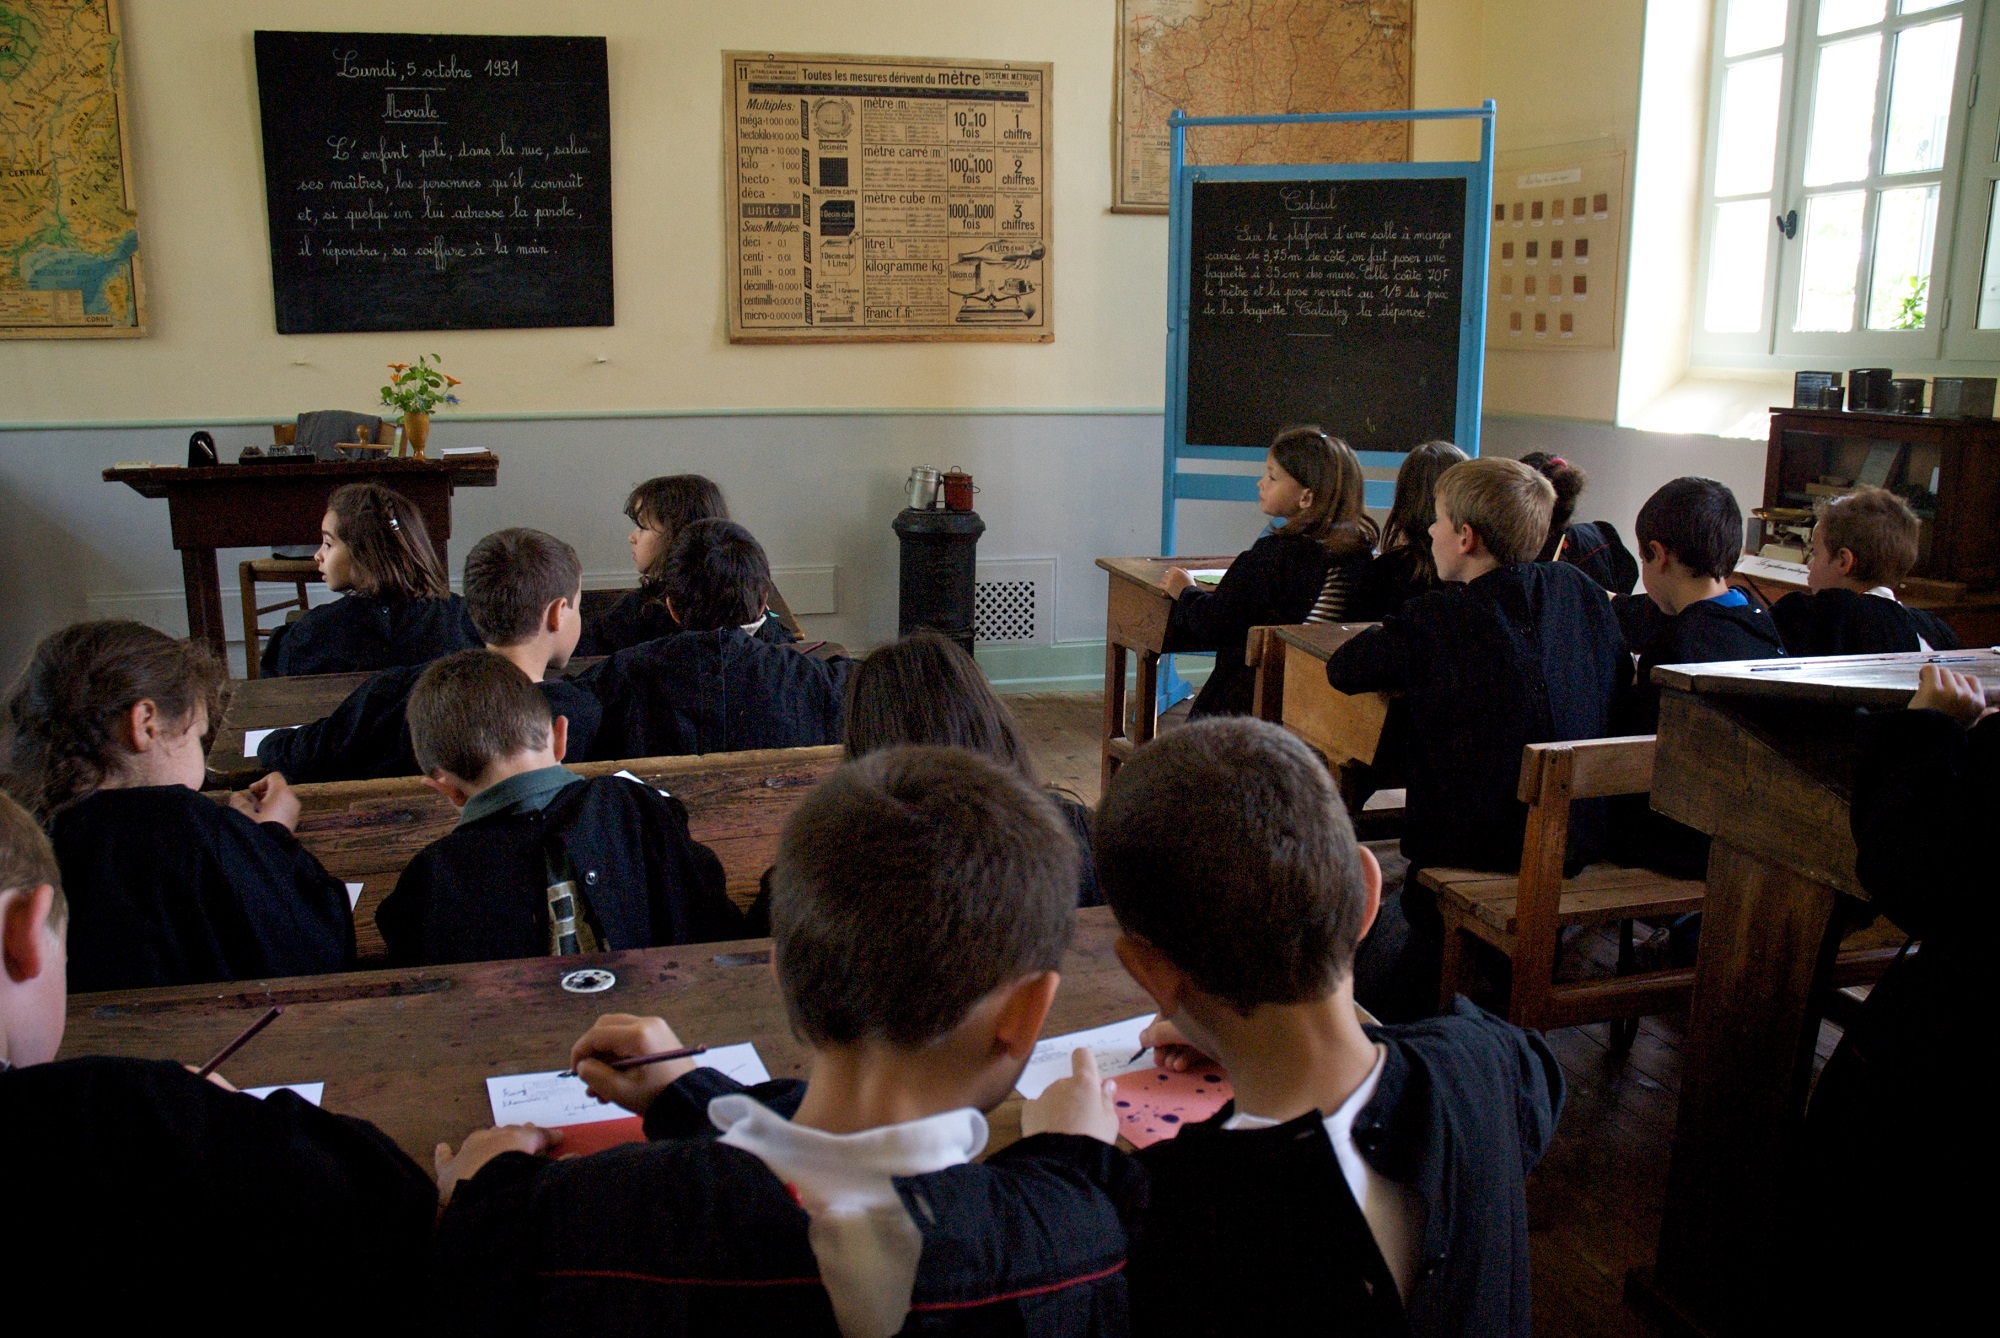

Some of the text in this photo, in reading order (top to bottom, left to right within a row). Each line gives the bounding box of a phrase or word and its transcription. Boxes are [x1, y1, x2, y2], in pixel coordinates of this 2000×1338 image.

[406, 62, 417, 76] 5
[422, 54, 472, 78] octobre
[484, 59, 519, 77] 1931
[739, 67, 748, 80] 11
[802, 68, 832, 81] Toutes
[834, 69, 848, 81] les
[850, 73, 888, 83] mesures
[889, 71, 924, 84] dérivent
[925, 72, 936, 84] du
[938, 70, 981, 86] mètre
[985, 71, 1040, 82] SYSTÈME MÉTRIQUE
[381, 92, 440, 119] Morale
[864, 96, 893, 109] mètre
[74, 112, 89, 134] JURA
[740, 113, 763, 128] méga
[954, 112, 967, 127] 10
[974, 113, 986, 127] 10
[1015, 114, 1019, 128] 1
[962, 127, 980, 138] fois
[1003, 129, 1032, 140] chiffre
[458, 141, 491, 157] dans
[496, 132, 515, 156] la
[521, 146, 550, 161] rue,
[553, 133, 590, 155] salue
[740, 143, 768, 158] myria
[864, 145, 928, 158] mètre carré
[741, 157, 759, 169] kilo
[949, 158, 969, 173] 100
[974, 158, 993, 173] 100
[1014, 159, 1022, 174] 2
[9, 169, 46, 177] CENTRAL
[741, 172, 800, 185] hecto 100
[962, 173, 981, 184] fois
[1002, 174, 1035, 185] chiffres
[297, 180, 324, 190] ses
[394, 168, 414, 189] les
[419, 179, 482, 201] personnes
[489, 167, 527, 197] qu'il
[531, 172, 583, 189] connaît
[741, 186, 800, 199] déca 10
[864, 191, 926, 204] mètre cube
[1280, 187, 1337, 211] Calcul
[322, 206, 338, 219] si
[421, 195, 445, 219] lui
[451, 204, 505, 219] adresse
[509, 195, 528, 218] la
[748, 203, 780, 216] unité
[949, 204, 968, 218] 1000
[974, 204, 994, 219] 1000
[1013, 205, 1022, 219] 3
[962, 219, 980, 229] fois
[1001, 219, 1035, 230] chiffres
[742, 235, 761, 247] déci
[1235, 224, 1262, 241] Sur
[1266, 221, 1278, 240] le
[1284, 221, 1329, 250] plafond
[1332, 224, 1366, 240] d'une
[1371, 220, 1397, 240] salle
[1401, 226, 1410, 240] à
[865, 237, 885, 249] litre
[994, 245, 1011, 253] Litre
[298, 235, 312, 256] il
[391, 244, 408, 256] sa
[414, 235, 466, 270] coiffure
[471, 241, 486, 255] à
[495, 232, 509, 254] la
[742, 250, 764, 261] centi
[1205, 249, 1242, 261] carrée
[1246, 248, 1260, 260] de
[1306, 250, 1319, 262] de
[1351, 254, 1365, 262] on
[1367, 244, 1388, 269] fait
[1391, 254, 1420, 271] poser
[1424, 254, 1446, 262] une
[743, 265, 762, 276] milli
[865, 259, 928, 274] kilogramme
[1204, 263, 1247, 286] baguette
[1251, 266, 1260, 279] à
[1305, 266, 1323, 279] des
[1359, 263, 1388, 281] Elle
[1393, 268, 1422, 281] coûte
[744, 279, 774, 291] décimilli
[1204, 280, 1448, 307] le mètre et la pose revient au 1/5 du prix
[744, 309, 767, 320] micro
[866, 306, 892, 319] franc
[1203, 302, 1216, 315] de
[1220, 298, 1235, 314] la
[1295, 299, 1349, 325] Calculez
[1356, 299, 1372, 317] la
